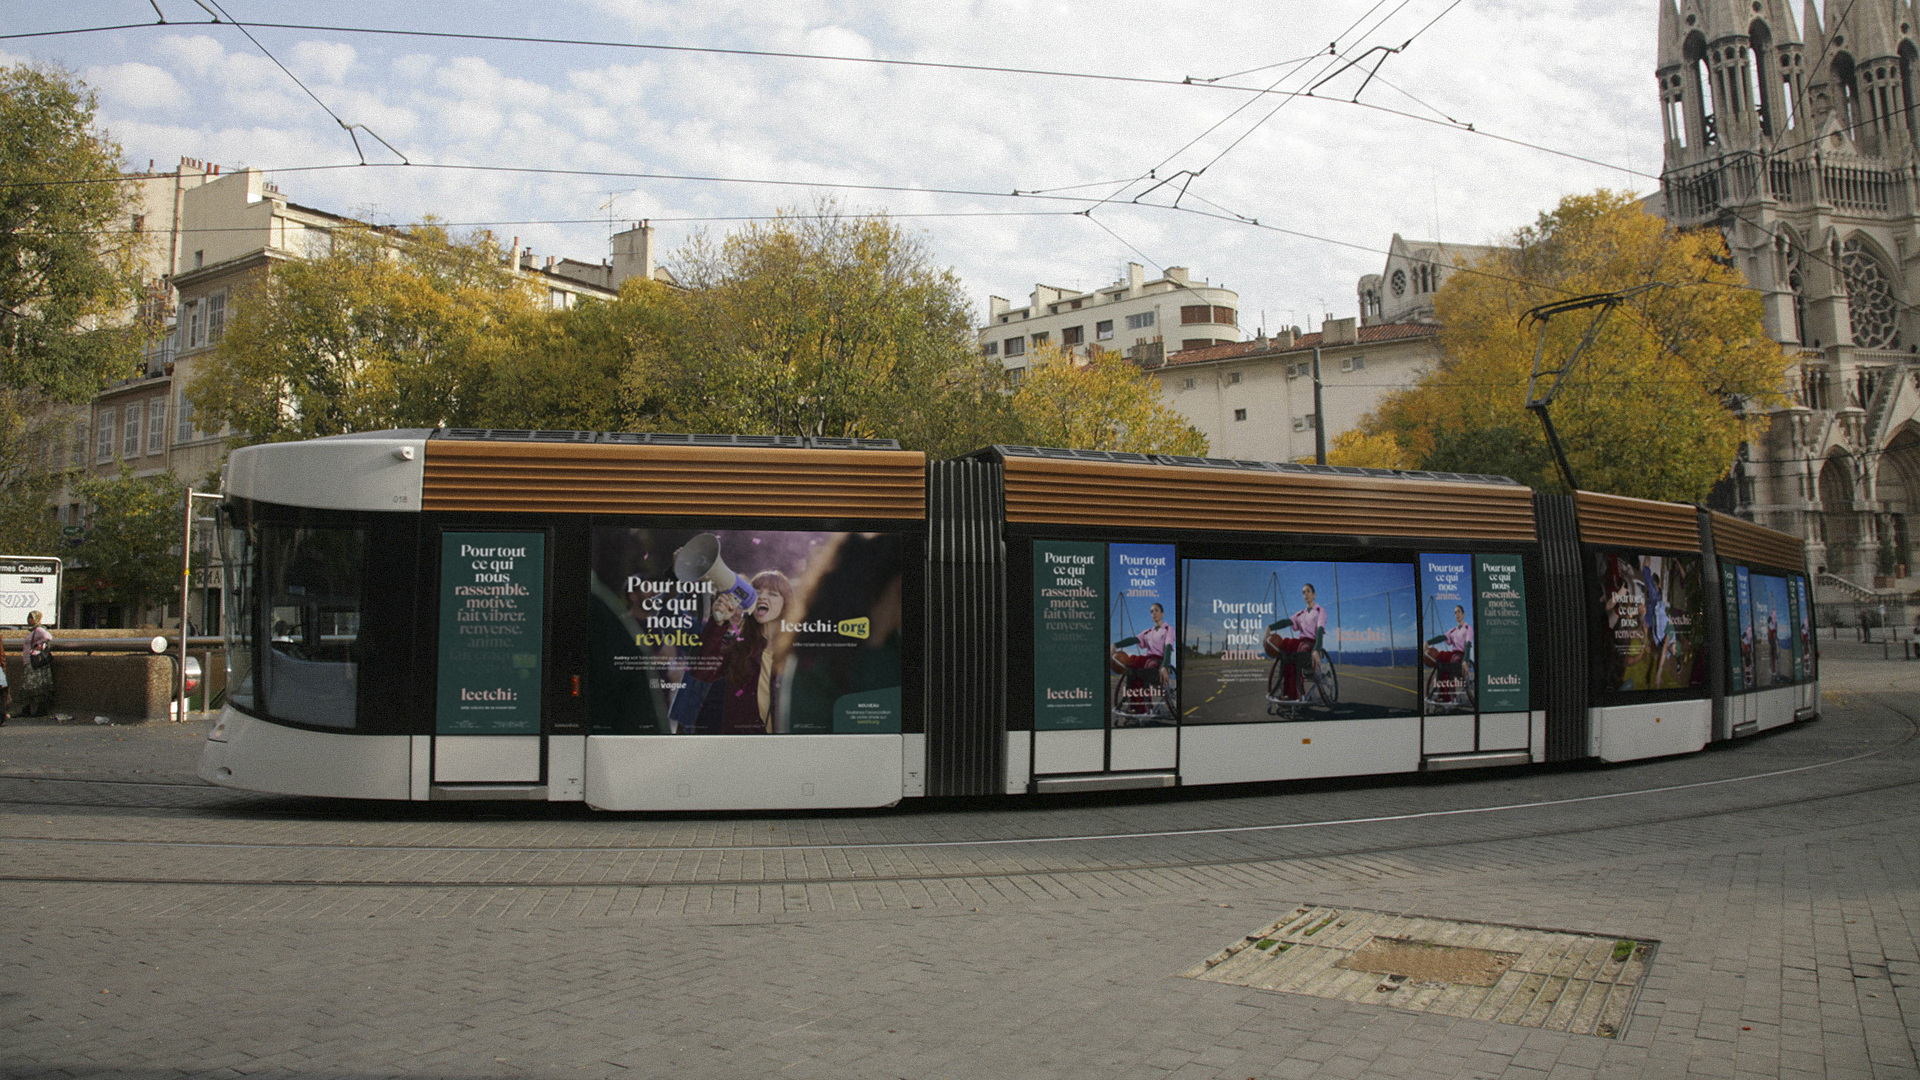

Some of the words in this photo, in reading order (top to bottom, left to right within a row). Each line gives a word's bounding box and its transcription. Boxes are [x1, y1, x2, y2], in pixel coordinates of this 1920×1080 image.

[461, 544, 496, 557] Pour
[497, 546, 526, 557] tout
[1044, 552, 1072, 564] Pour
[1072, 554, 1094, 564] tout
[1120, 554, 1144, 565] Pour
[1144, 556, 1166, 566] tout
[472, 560, 488, 570] ce
[490, 557, 514, 573] qui
[1053, 566, 1066, 575] ce
[1067, 564, 1086, 578] qui
[1428, 563, 1449, 572] Pour
[1449, 564, 1464, 572] tout
[1483, 563, 1500, 572] Pour
[1500, 564, 1516, 572] tout
[1128, 567, 1140, 576] ce
[1141, 565, 1158, 578] qui
[1499, 572, 1511, 582] qui
[475, 573, 510, 583] nous
[1056, 577, 1083, 586] nous
[1130, 577, 1156, 586] nous
[1436, 574, 1445, 582] ce
[1446, 572, 1458, 584] qui
[455, 583, 530, 596] rassemble.
[627, 576, 674, 594] Pour
[675, 580, 714, 594] tout
[1438, 583, 1457, 591] nous
[1492, 582, 1510, 590] nous
[1041, 586, 1098, 598] rassemble.
[1126, 586, 1160, 597] anime.
[1436, 591, 1461, 600] anime.
[1482, 590, 1521, 599] rassemble.
[466, 596, 518, 608] motive.
[1050, 597, 1089, 608] motive.
[1612, 592, 1629, 604] Pour
[642, 597, 664, 611] ce
[666, 594, 698, 616] qui
[1212, 599, 1245, 614] Pour
[1246, 602, 1274, 614] tout
[457, 608, 482, 622] fait
[482, 608, 526, 622] vibrer.
[1044, 608, 1062, 619] fait
[1062, 608, 1096, 620] vibrer.
[1618, 606, 1627, 615] ce
[1627, 604, 1639, 619] qui
[646, 614, 693, 629] nous
[1223, 618, 1238, 629] ce
[1241, 614, 1262, 633] qui
[1621, 618, 1638, 628] nous
[460, 624, 523, 635] renverse.
[1336, 627, 1385, 641] leetchi:
[468, 634, 514, 648] anime.
[635, 629, 703, 647] révolte.
[1227, 634, 1260, 645] nous
[1221, 646, 1265, 660] anime.
[1433, 677, 1466, 688] leetchi:
[1488, 674, 1521, 685] leetchi:
[660, 682, 687, 691] vague
[1122, 686, 1166, 697] leetchi:
[461, 688, 518, 700] leetchi:
[1046, 687, 1093, 700] leetchi:
